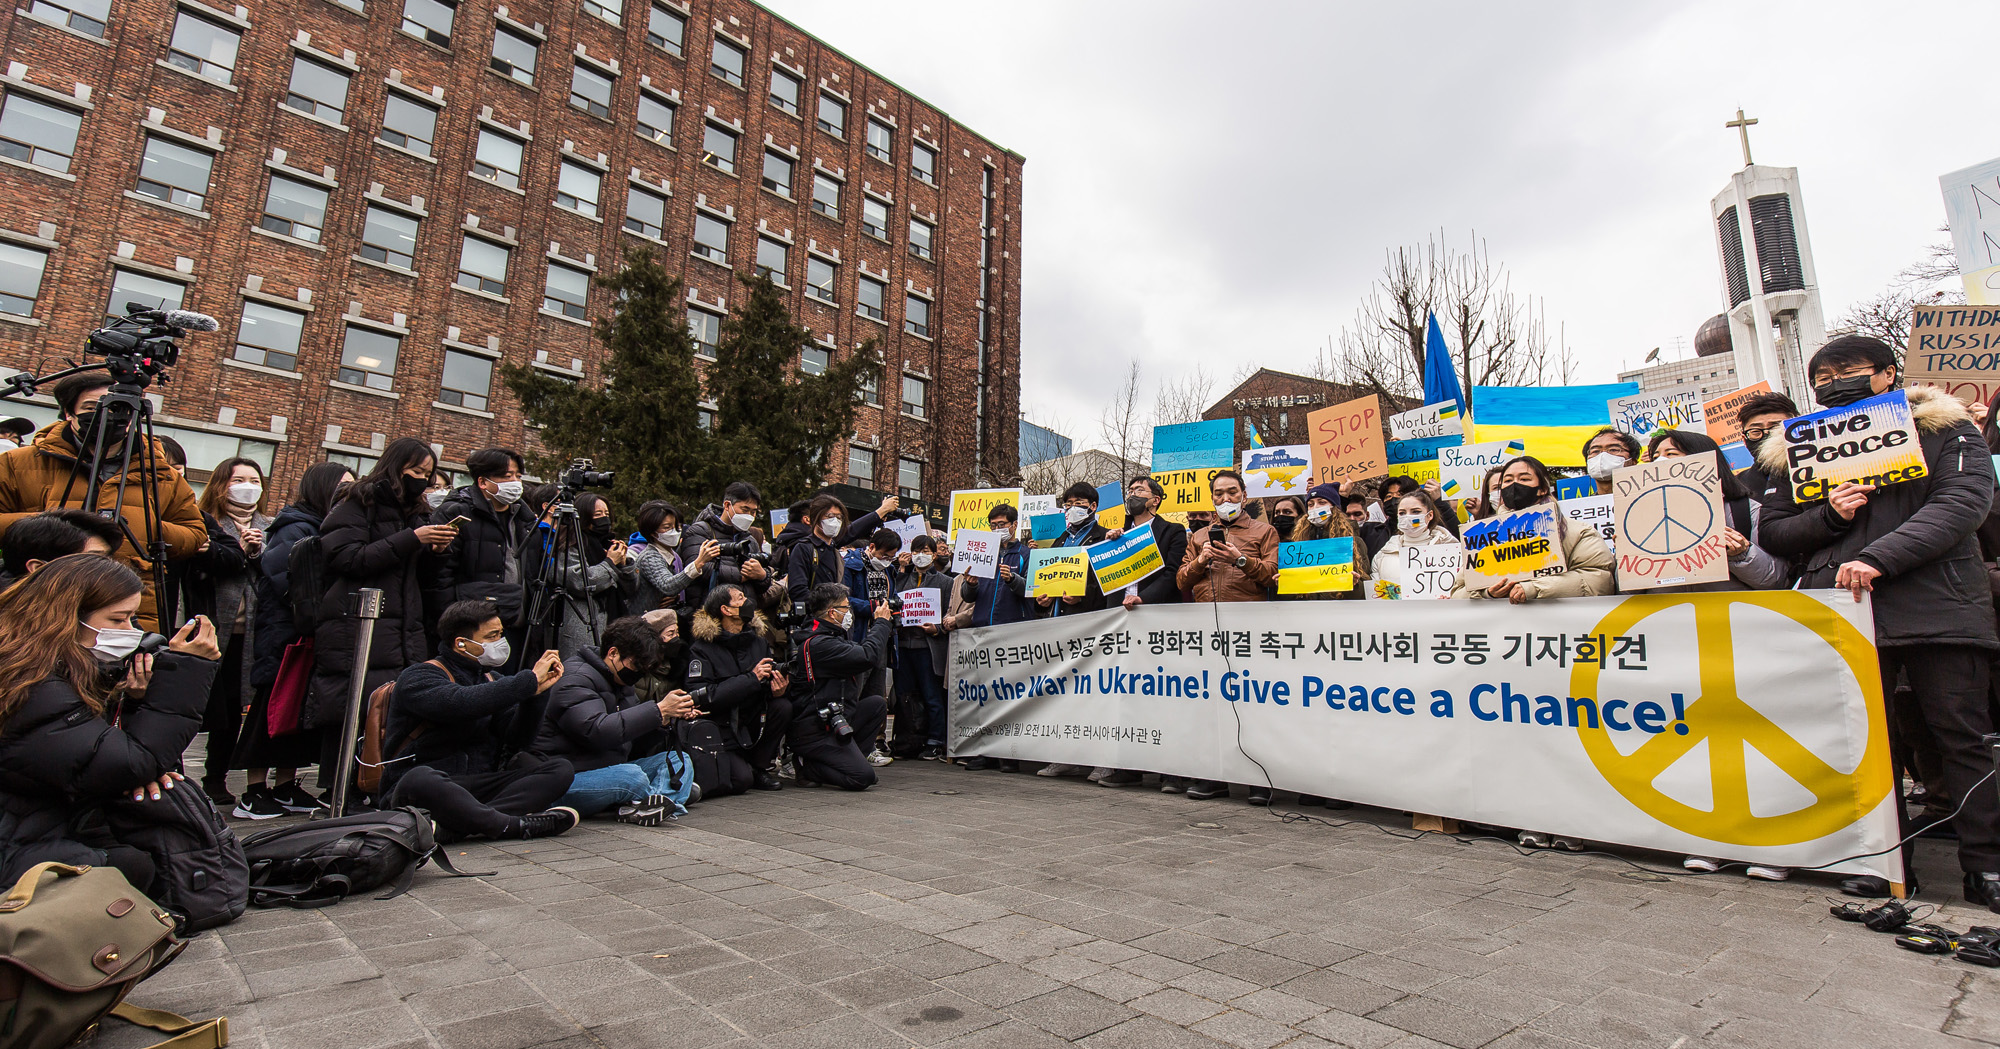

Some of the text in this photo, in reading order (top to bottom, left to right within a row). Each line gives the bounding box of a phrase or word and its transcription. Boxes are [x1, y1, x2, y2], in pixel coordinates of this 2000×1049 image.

[1617, 391, 1696, 415] STAND WITH
[1705, 403, 1723, 417] НЕТ
[1180, 423, 1198, 433] the
[1319, 408, 1374, 445] STOP
[1393, 411, 1439, 430] World
[1784, 414, 1872, 443] Give
[1186, 430, 1229, 444] seeds
[1167, 450, 1227, 466] pockets
[1443, 448, 1504, 467] Stand
[1787, 430, 1909, 468] Peace
[1154, 471, 1196, 486] PUTIN
[1617, 461, 1719, 497] DIALOGUE
[1792, 465, 1817, 484] a
[958, 498, 982, 513] NO!
[951, 517, 967, 531] IN
[967, 540, 987, 553] 전쟁은
[1464, 528, 1535, 551] WAR has
[958, 551, 993, 566] 답이 아니다
[1492, 539, 1550, 563] WINNER
[1618, 535, 1726, 578] NOT WAR
[1038, 555, 1080, 567] STOP WAR
[1100, 550, 1160, 584] REFUGEES WELCOME
[1038, 570, 1083, 581] STOP PUTIN
[1533, 565, 1564, 578] PSPD
[958, 648, 991, 669] 러시아의
[995, 641, 1064, 667] 우크라이나
[1067, 636, 1096, 660] 침공
[1099, 630, 1131, 655] 중단
[1147, 630, 1203, 656] 평화적
[1210, 630, 1251, 658] 해결
[1259, 632, 1305, 659] 촉구
[1314, 632, 1419, 663] 시민사회
[1430, 633, 1490, 665] 공동
[1502, 633, 1648, 670] 기자회견
[958, 665, 1690, 736] Stop the War in Ukraine! Give Peace a Chance!
[993, 723, 1023, 738] 28일(월)
[1024, 724, 1040, 737] 오전
[1041, 724, 1061, 739] 11시,
[1063, 724, 1081, 739] 주한
[1151, 729, 1162, 745] 앞
